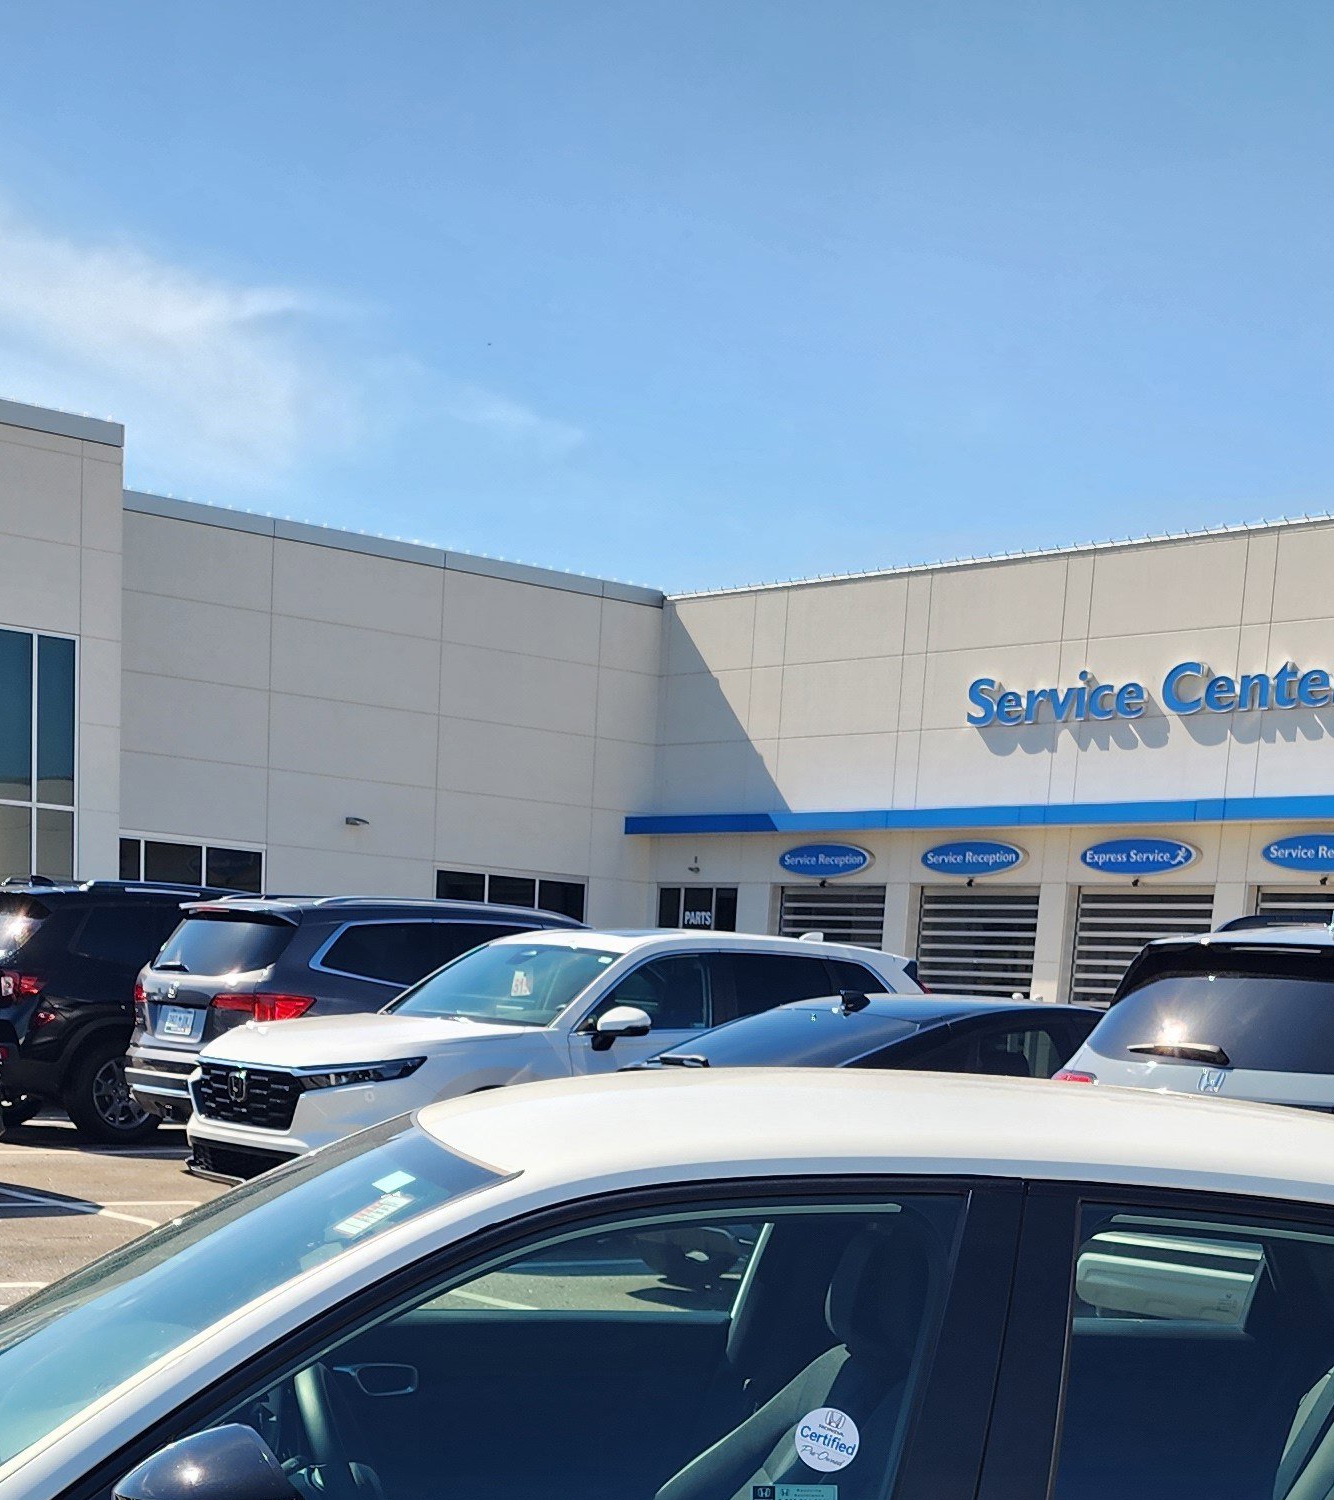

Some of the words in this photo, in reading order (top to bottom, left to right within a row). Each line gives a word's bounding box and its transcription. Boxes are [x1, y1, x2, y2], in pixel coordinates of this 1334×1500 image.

[967, 669, 1147, 727] Service
[783, 853, 816, 865] Service
[818, 853, 864, 867] Reception
[927, 851, 963, 864] Service
[965, 850, 1016, 866] Reception
[1086, 850, 1127, 864] Express
[1129, 849, 1170, 862] Service
[1269, 845, 1315, 859] Service
[684, 910, 712, 926] PARTS
[800, 1425, 856, 1456] Certified
[800, 1445, 845, 1467] Pre-Owned
